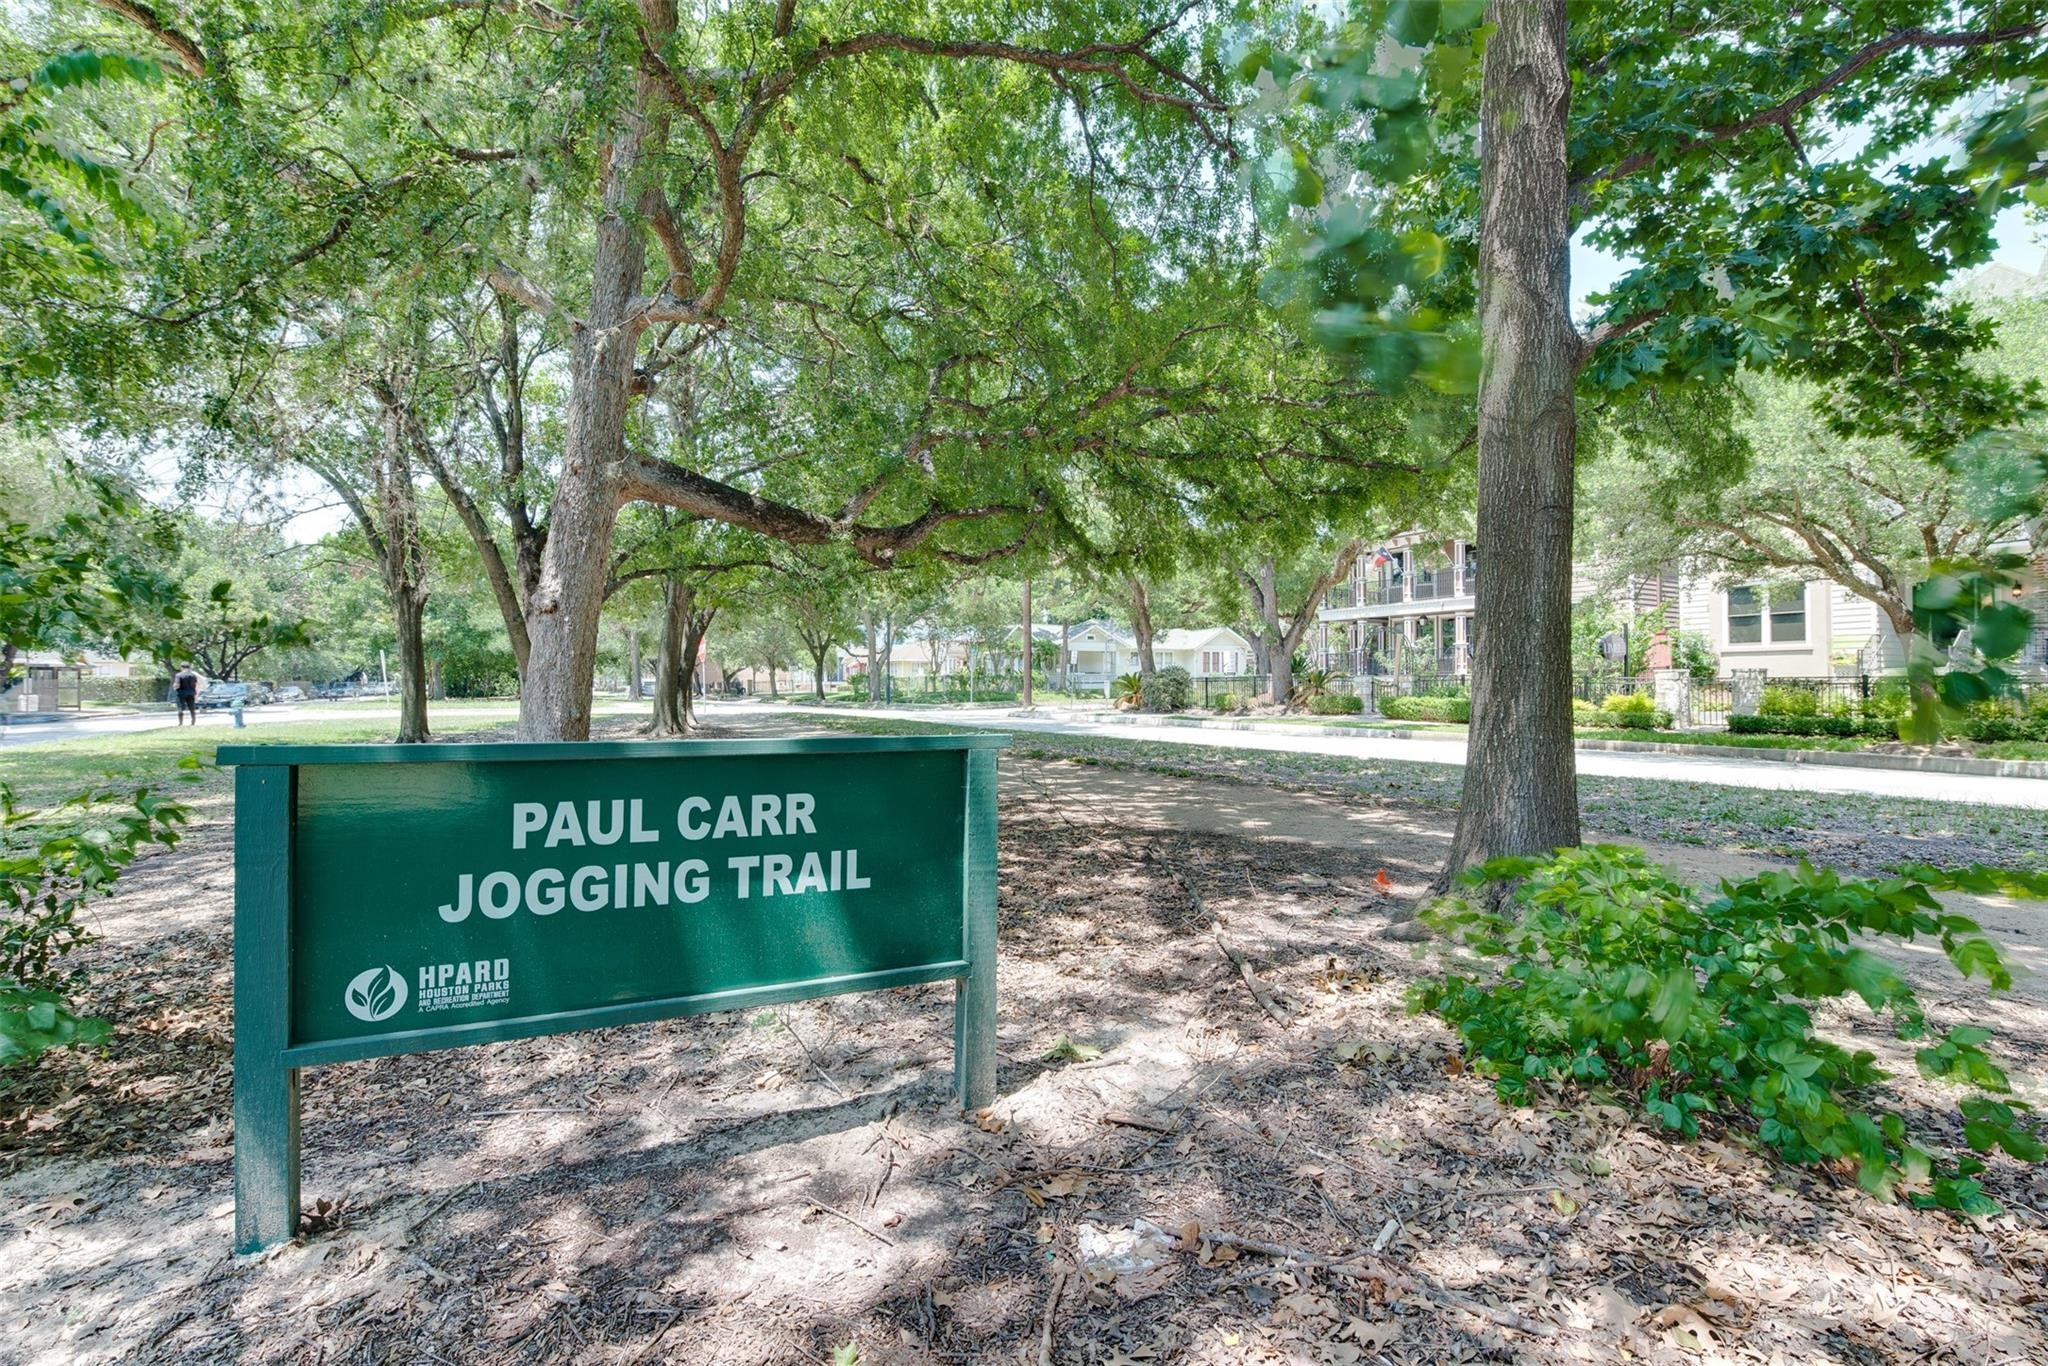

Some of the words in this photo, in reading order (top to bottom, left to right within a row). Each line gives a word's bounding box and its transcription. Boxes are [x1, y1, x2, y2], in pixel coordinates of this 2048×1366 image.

[513, 796, 660, 849] PAUL
[677, 793, 817, 840] CARR
[438, 861, 711, 923] JOGGING
[728, 849, 871, 899] TRAIL
[419, 958, 509, 989] HPARD
[418, 999, 431, 1007] AND
[433, 995, 469, 1006] RECREATION
[472, 990, 509, 1002] DEPARTMENT
[419, 985, 469, 999] HOUSTON
[474, 981, 509, 993] PARKS
[425, 1004, 449, 1013] CAPRA
[451, 1000, 485, 1009] Accredited
[487, 997, 510, 1007] Agency
